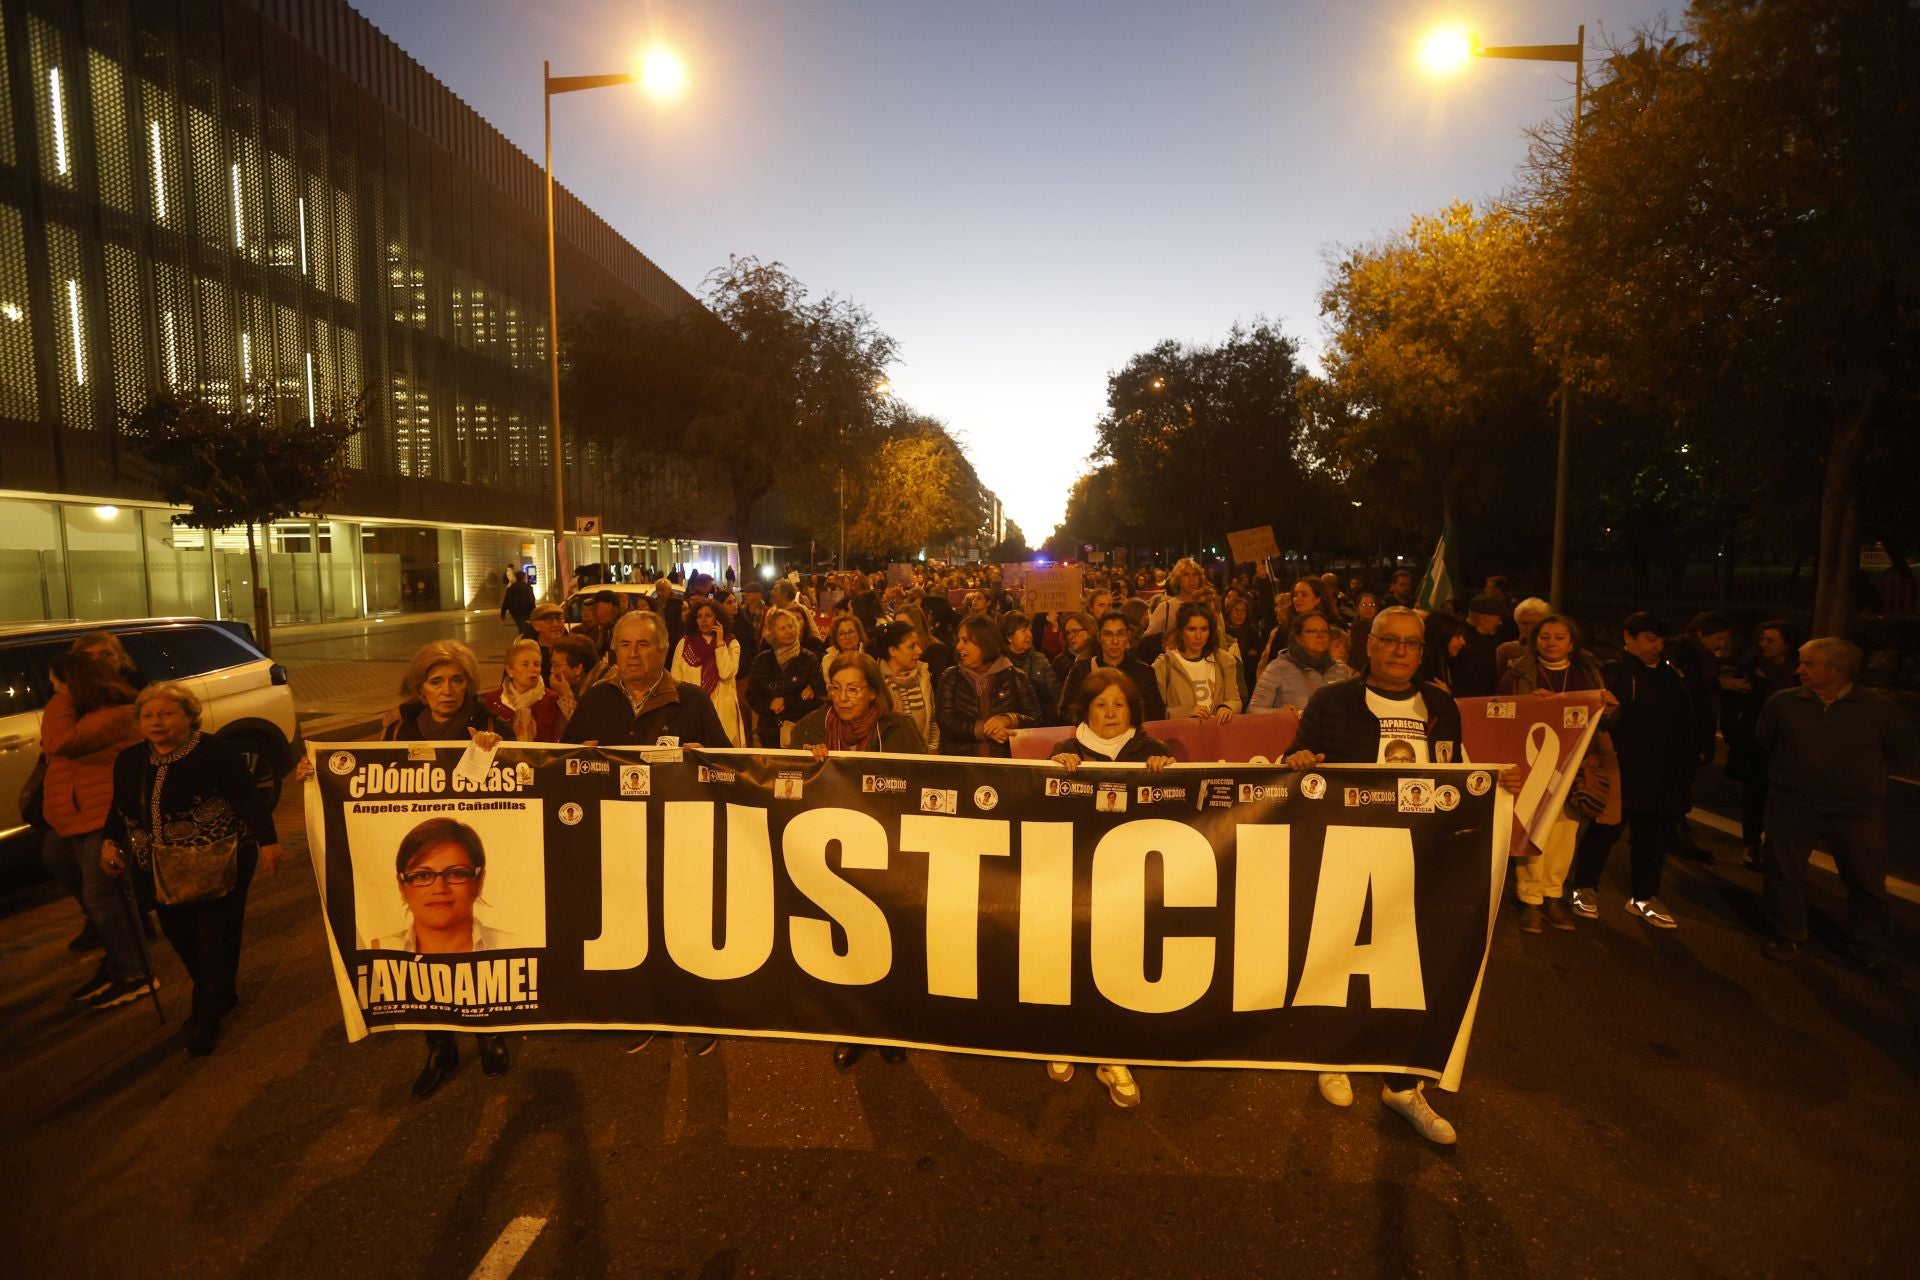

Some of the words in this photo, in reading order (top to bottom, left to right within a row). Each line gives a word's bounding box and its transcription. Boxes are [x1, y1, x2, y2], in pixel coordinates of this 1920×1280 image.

[350, 762, 446, 799] ¿Dónde
[886, 779, 907, 790] MEDIOS
[1071, 783, 1094, 794] MEDIOS
[1163, 788, 1186, 799] MEDIOS
[1264, 786, 1288, 798] MEDIOS
[1371, 791, 1395, 803] MEDIOS
[353, 803, 409, 815] Ángeles
[411, 803, 456, 812] Zurera
[457, 801, 526, 812] Cañadillas
[583, 799, 1428, 1014] JUSTICIA
[357, 955, 538, 1010] ¡AYÚDAME!
